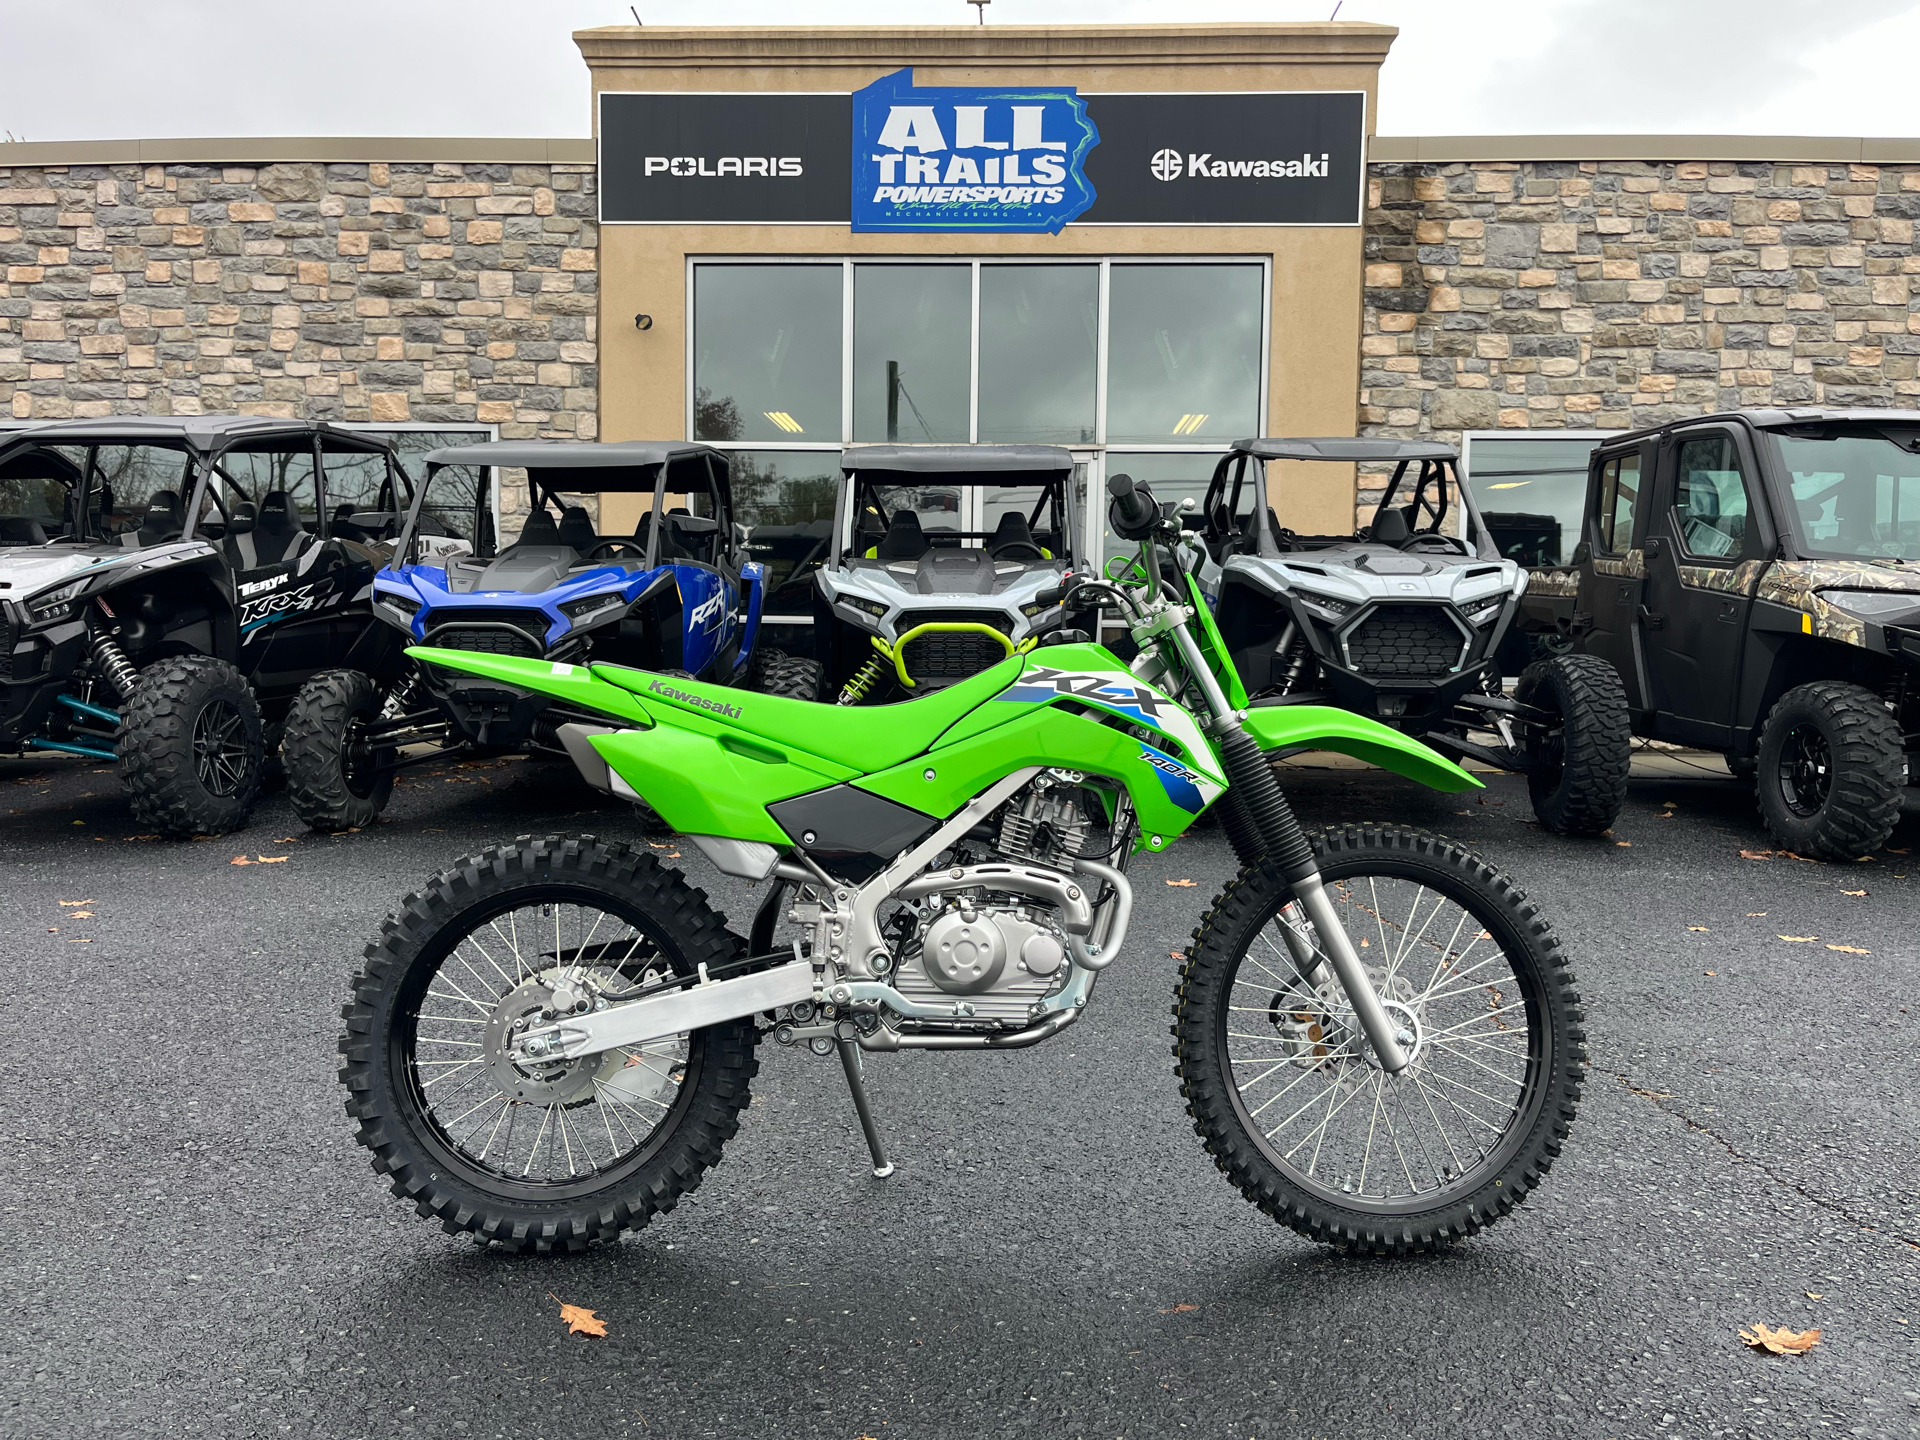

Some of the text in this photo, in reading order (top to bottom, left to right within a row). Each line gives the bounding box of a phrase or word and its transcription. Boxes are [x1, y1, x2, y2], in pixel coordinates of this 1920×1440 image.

[877, 105, 1067, 154] ALL
[644, 157, 803, 177] POLARIS
[872, 153, 1067, 185] TRAILS
[1188, 153, 1329, 178] Kawasaki
[872, 185, 1065, 204] POWERSPORTS
[237, 572, 289, 597] TERYX
[1766, 571, 1812, 585] XP
[1767, 581, 1799, 595] 1000
[688, 588, 724, 634] RZR
[647, 679, 743, 720] Kawasaki
[1018, 664, 1177, 719] KLX
